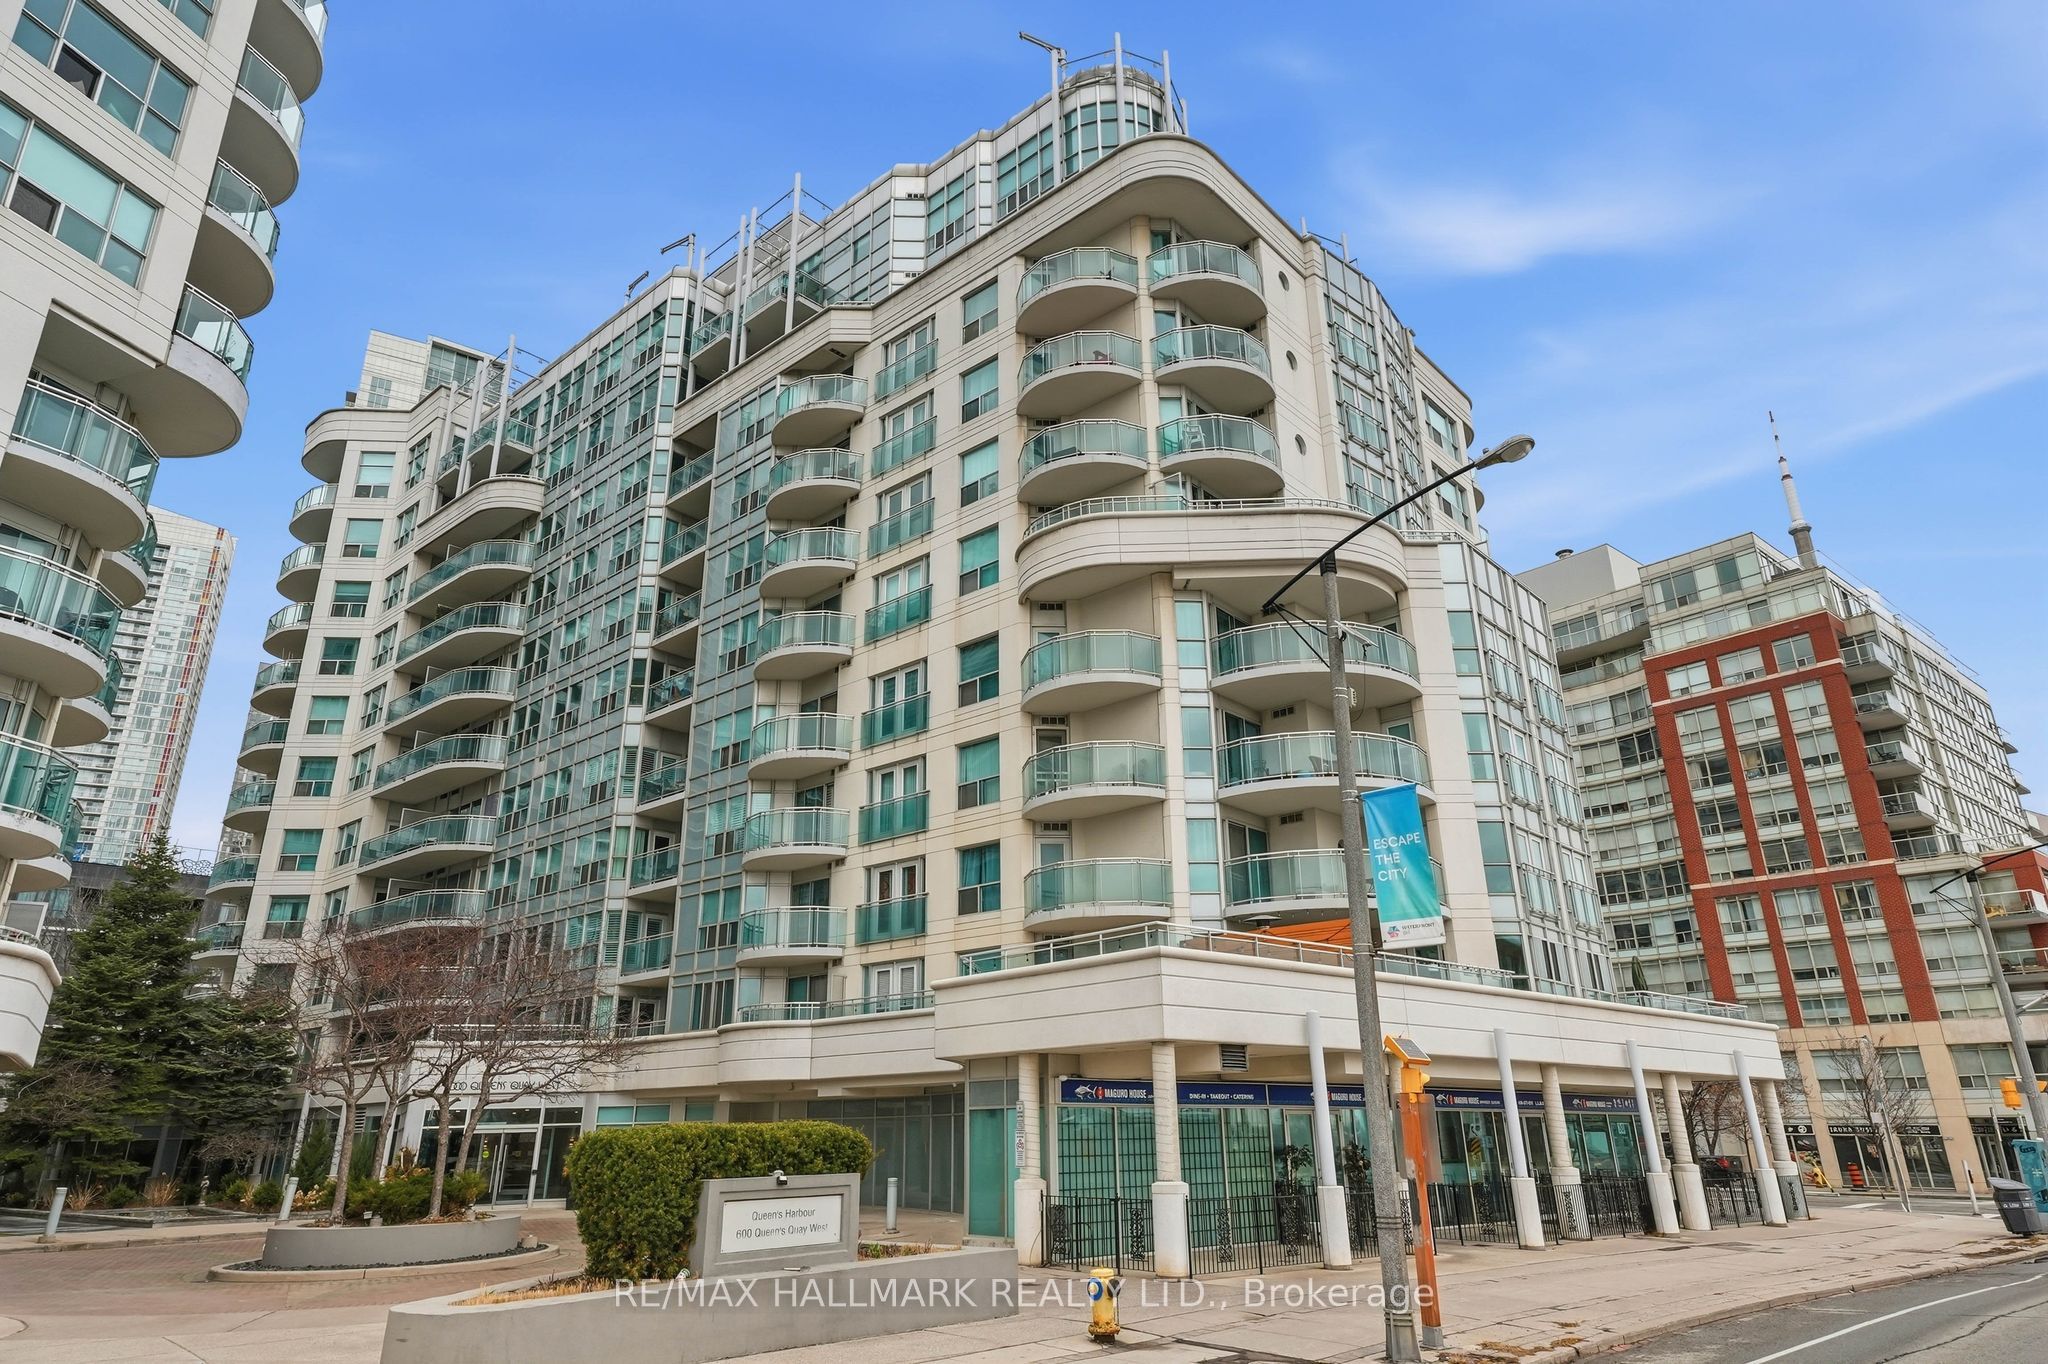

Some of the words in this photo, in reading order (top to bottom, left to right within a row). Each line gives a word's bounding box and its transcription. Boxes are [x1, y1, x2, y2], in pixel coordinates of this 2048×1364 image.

[1373, 832, 1421, 850] ESCAPE
[1375, 852, 1400, 866] THE
[1378, 867, 1407, 882] CITY
[1104, 1088, 1128, 1099] MAGURO
[1129, 1089, 1147, 1099] HOUSE
[751, 1210, 784, 1222] Queen's
[785, 1208, 815, 1219] Harbour
[736, 1228, 752, 1240] 600
[754, 1226, 786, 1238] Queen's
[787, 1224, 808, 1236] Quay
[809, 1223, 828, 1233] West
